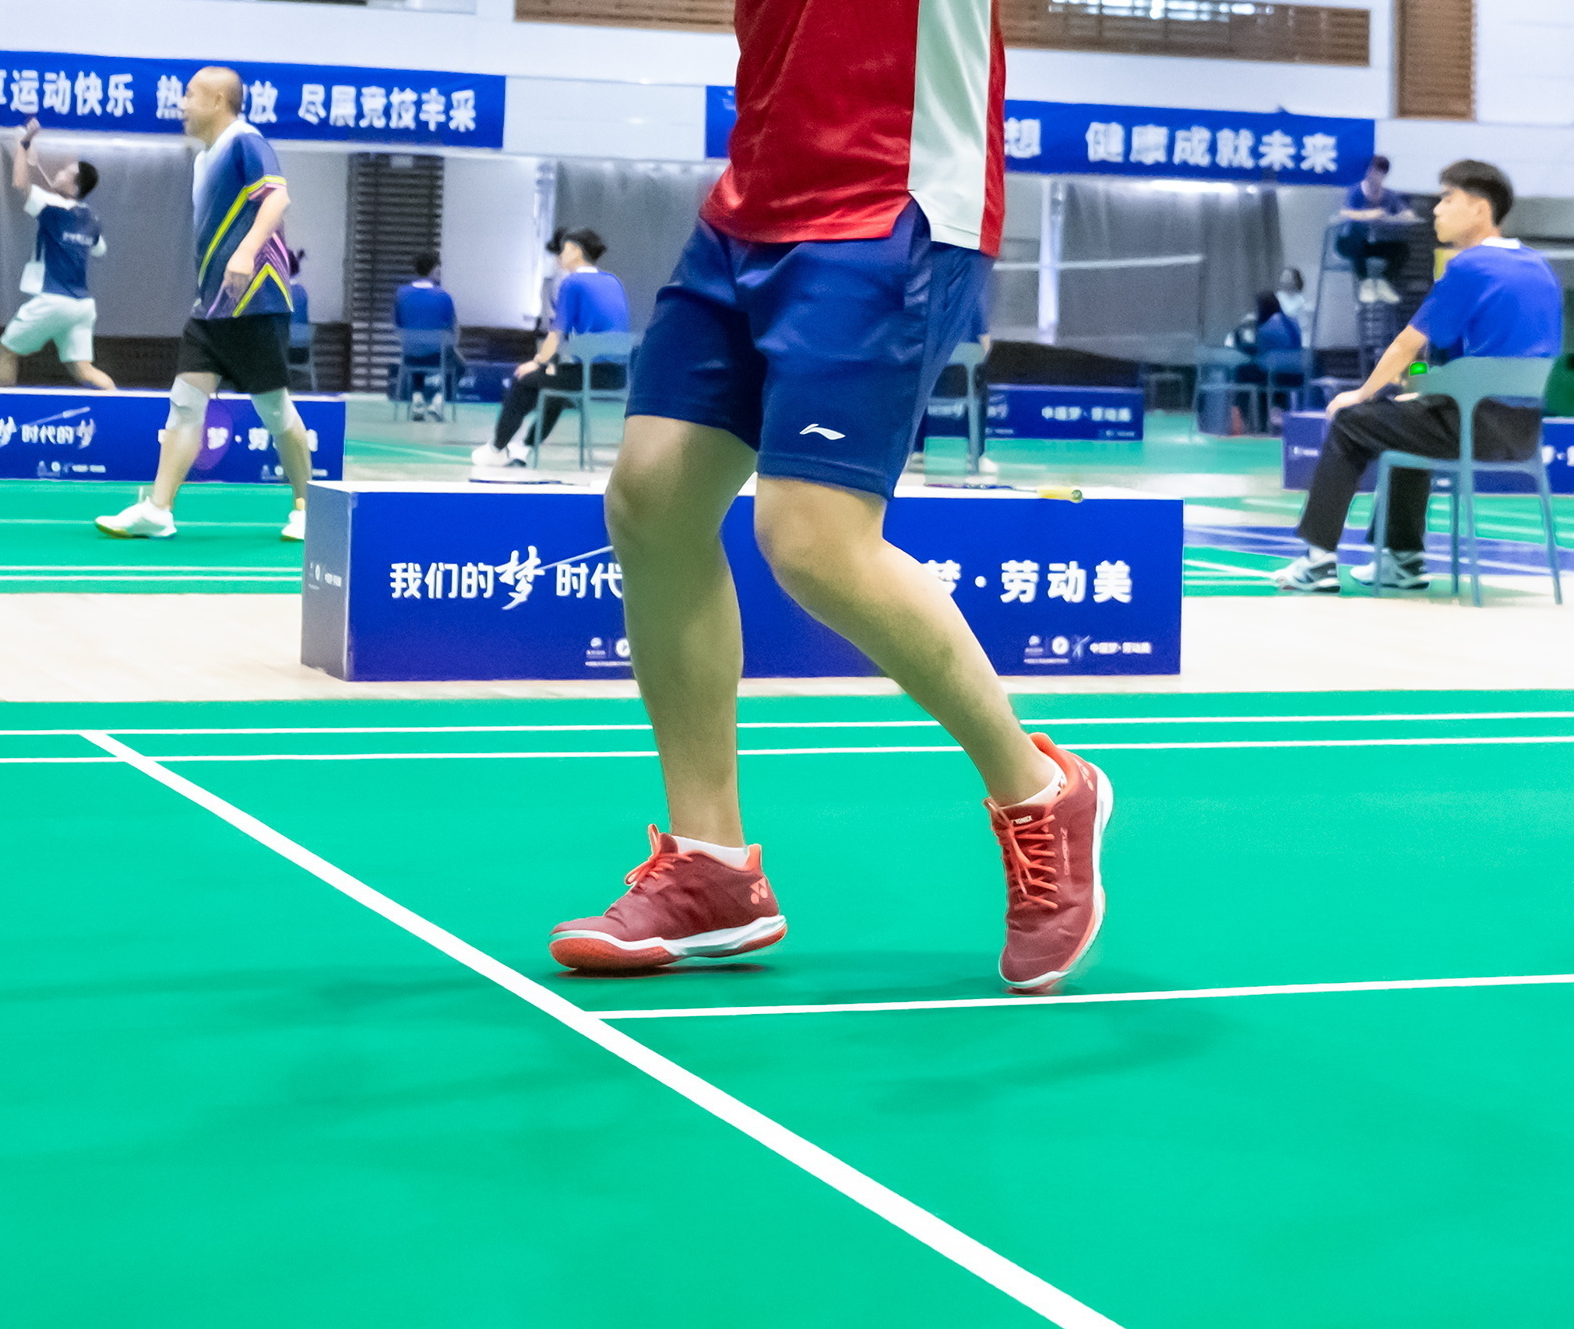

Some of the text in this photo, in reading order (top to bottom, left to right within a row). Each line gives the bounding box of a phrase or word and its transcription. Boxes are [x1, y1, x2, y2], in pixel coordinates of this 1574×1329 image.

[298, 83, 478, 133] 尽展竞技丰采
[1085, 120, 1339, 175] 健康成就未来
[389, 545, 546, 611] 我们的梦
